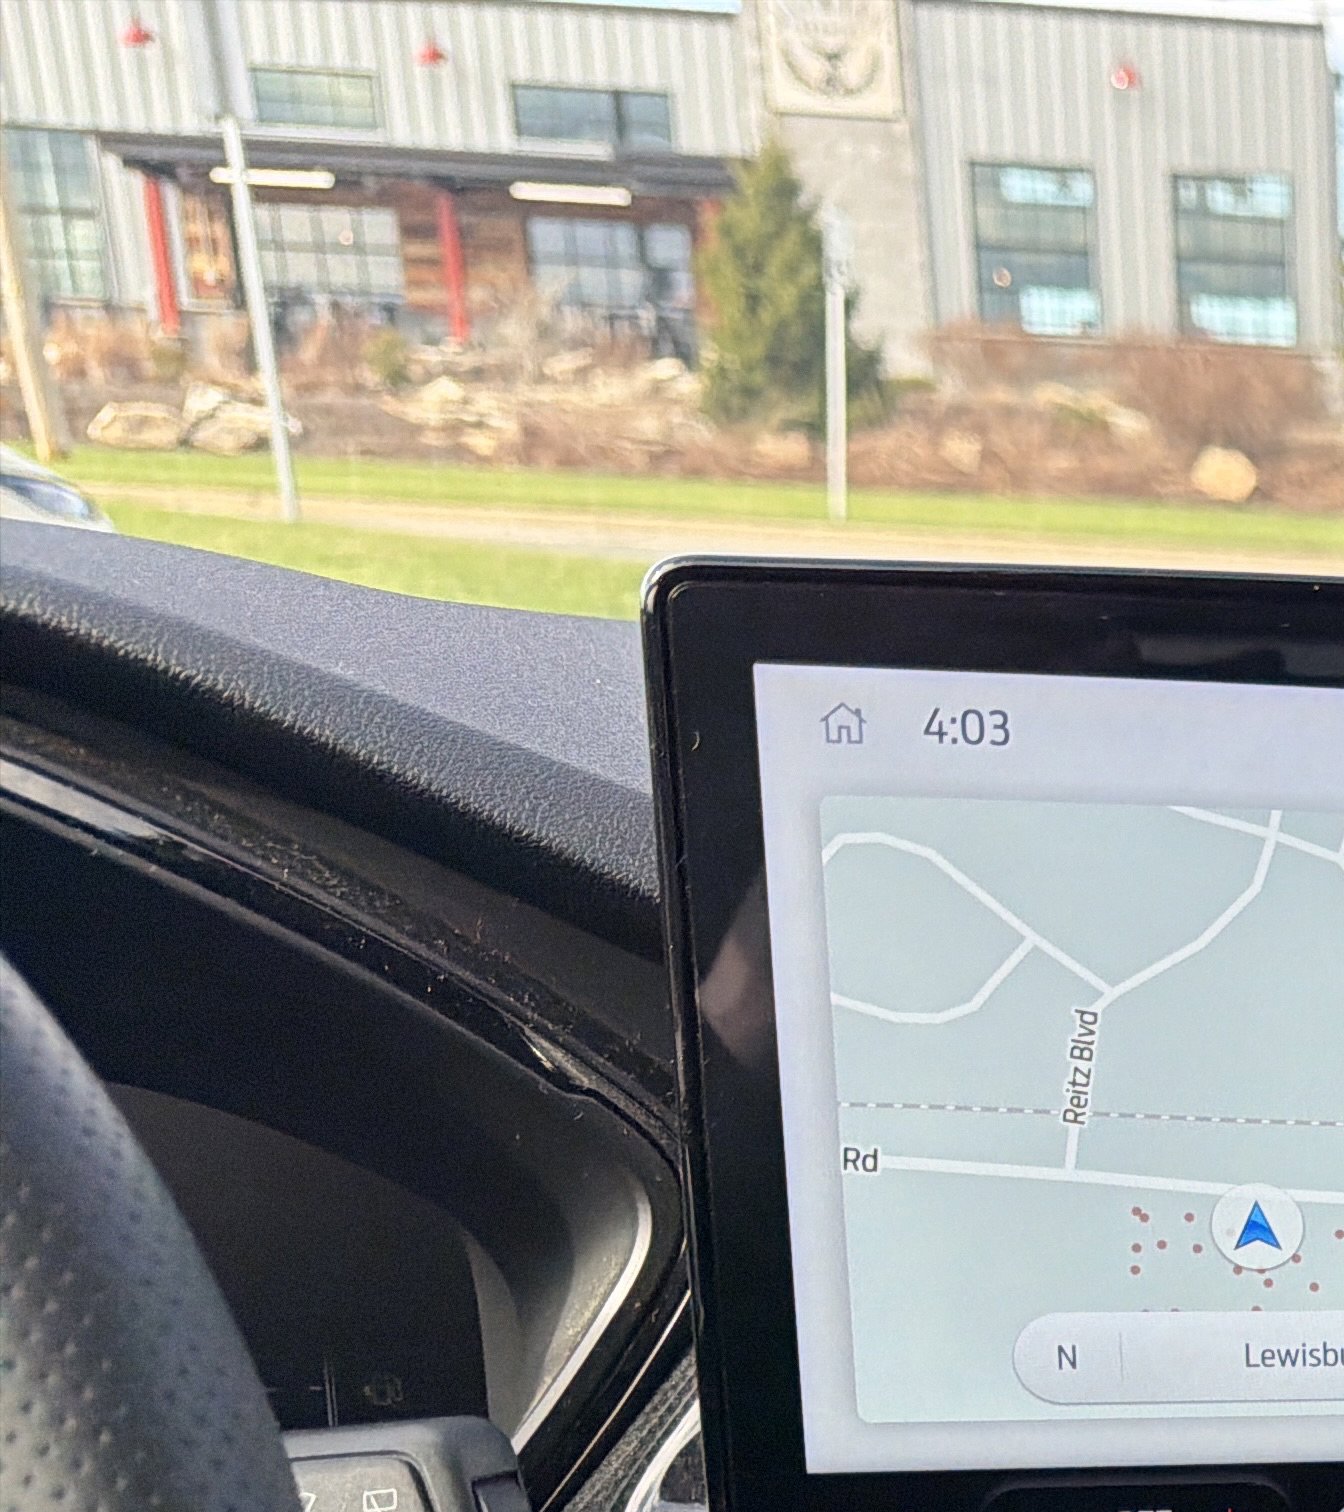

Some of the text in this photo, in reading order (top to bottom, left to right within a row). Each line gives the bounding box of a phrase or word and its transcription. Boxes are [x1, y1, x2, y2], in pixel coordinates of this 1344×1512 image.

[923, 707, 1010, 746] 4:03
[1062, 1008, 1099, 1126] Reitz Blvd
[843, 1146, 878, 1173] Rd
[1057, 1344, 1077, 1370] N
